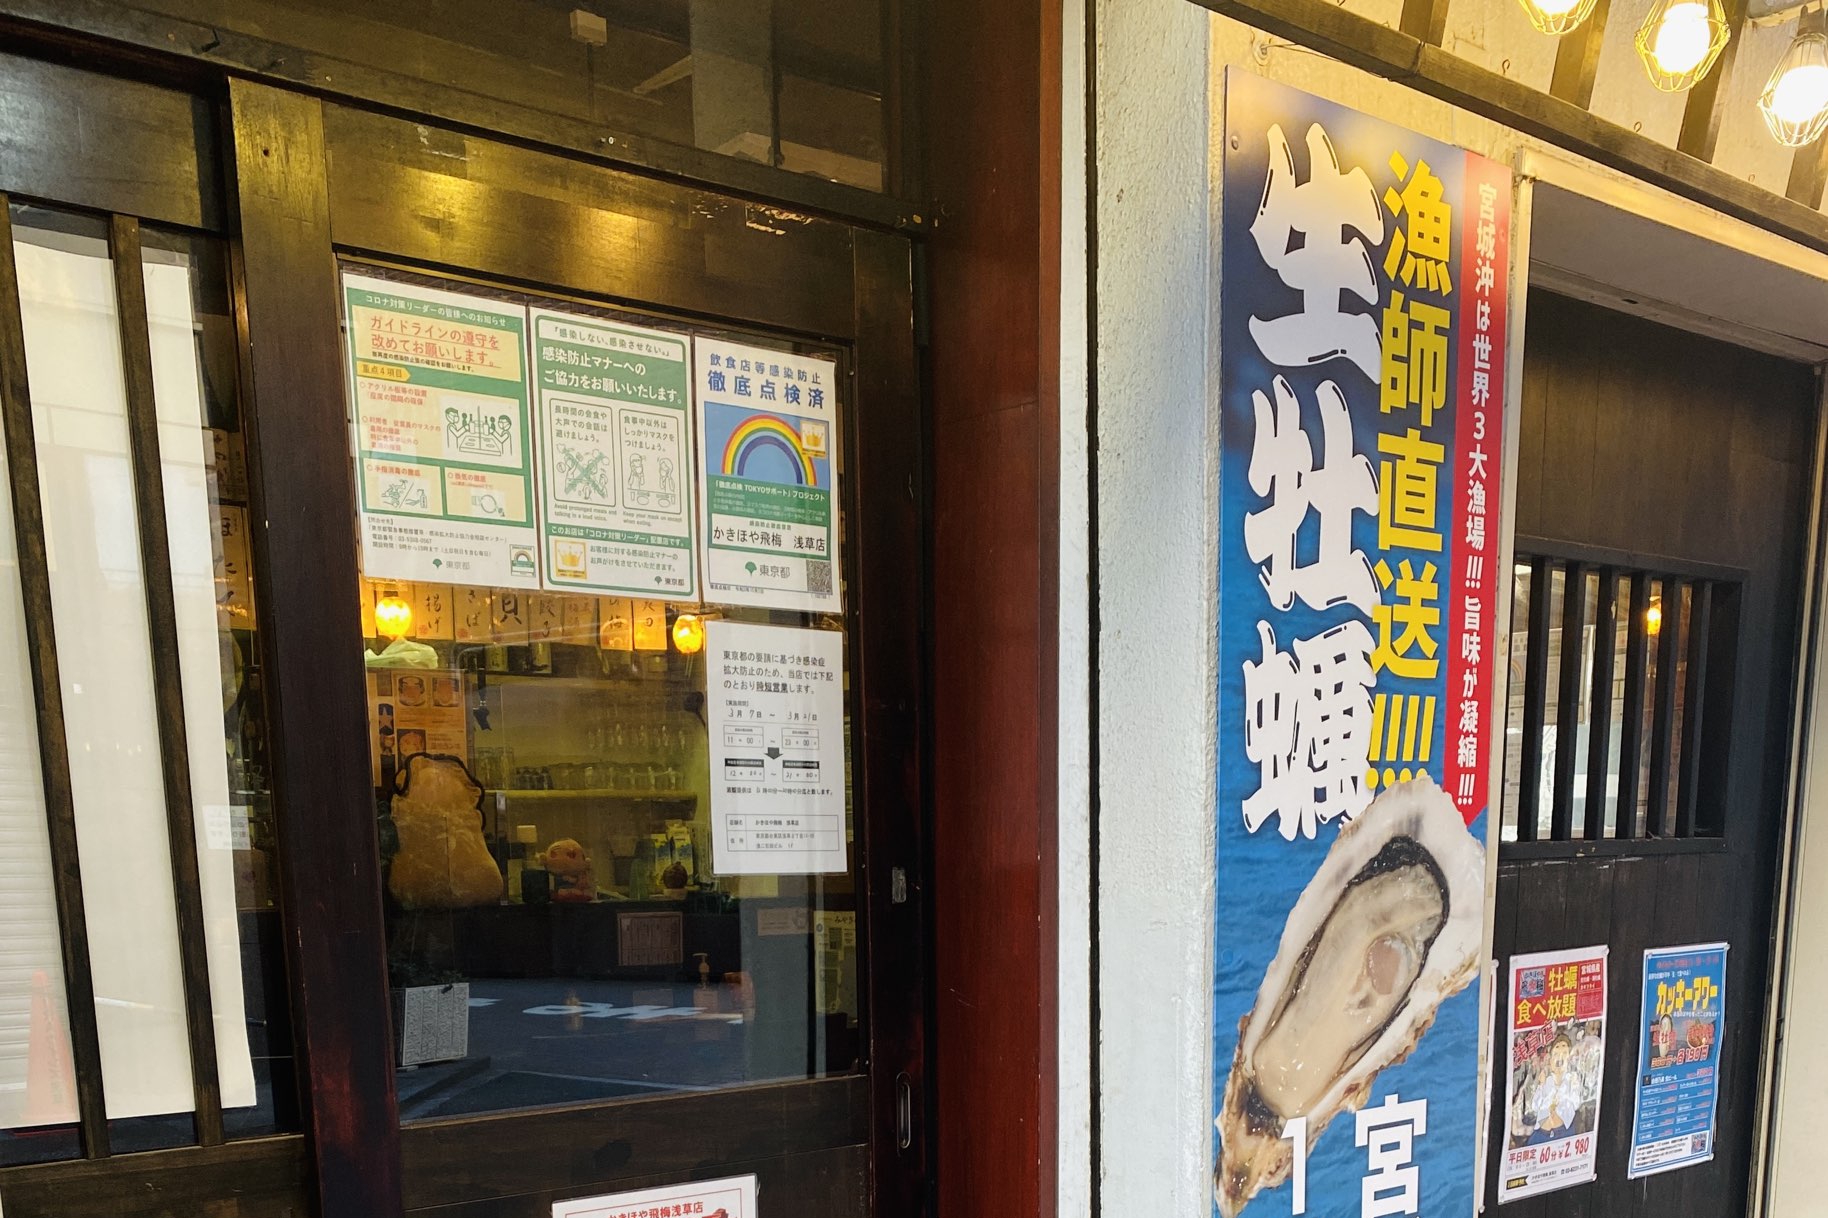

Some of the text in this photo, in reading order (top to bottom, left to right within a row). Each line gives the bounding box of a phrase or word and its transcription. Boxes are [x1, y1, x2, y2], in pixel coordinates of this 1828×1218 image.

[370, 315, 500, 349] ガイドラインの遵守を
[554, 326, 671, 357] 「感染しない、感染させない。」
[371, 333, 496, 368] 改めてお願いします。
[542, 347, 646, 376] 感染防止マナーへの
[710, 353, 822, 385] 飲食店等感染防止
[543, 366, 683, 404] ご協力をお願いいたします。
[708, 369, 824, 409] 徹底点検済
[555, 404, 608, 420] 長時間の会食や
[555, 417, 608, 432] 大声での会話は
[623, 415, 667, 429] 食事中以外は
[555, 429, 600, 443] 避けましょう。
[624, 427, 675, 442] しっかりマスクを
[624, 439, 667, 452] つけましょう。
[1241, 121, 1385, 842] 生牡蠣
[713, 527, 825, 552] かきほや飛梅 浅草店
[590, 545, 678, 560] お客様に対する感染防止マナーの
[445, 559, 471, 571] 東京都
[590, 557, 676, 572] お声がけをさせていただきます。
[760, 564, 791, 579] 東京都
[664, 577, 685, 587] 東京都
[723, 650, 825, 667] 東京都の要請に基づき感染症
[723, 666, 834, 682] 拡大防止のため、当店では下記
[723, 681, 815, 695] のとおり時短営業します。
[1548, 965, 1579, 993] 牡蠣
[1656, 976, 1718, 1016] カッキーアワー
[1516, 993, 1578, 1025] 食べ放題
[1512, 1020, 1556, 1068] 浅草店
[1508, 1149, 1537, 1164] 平日限定
